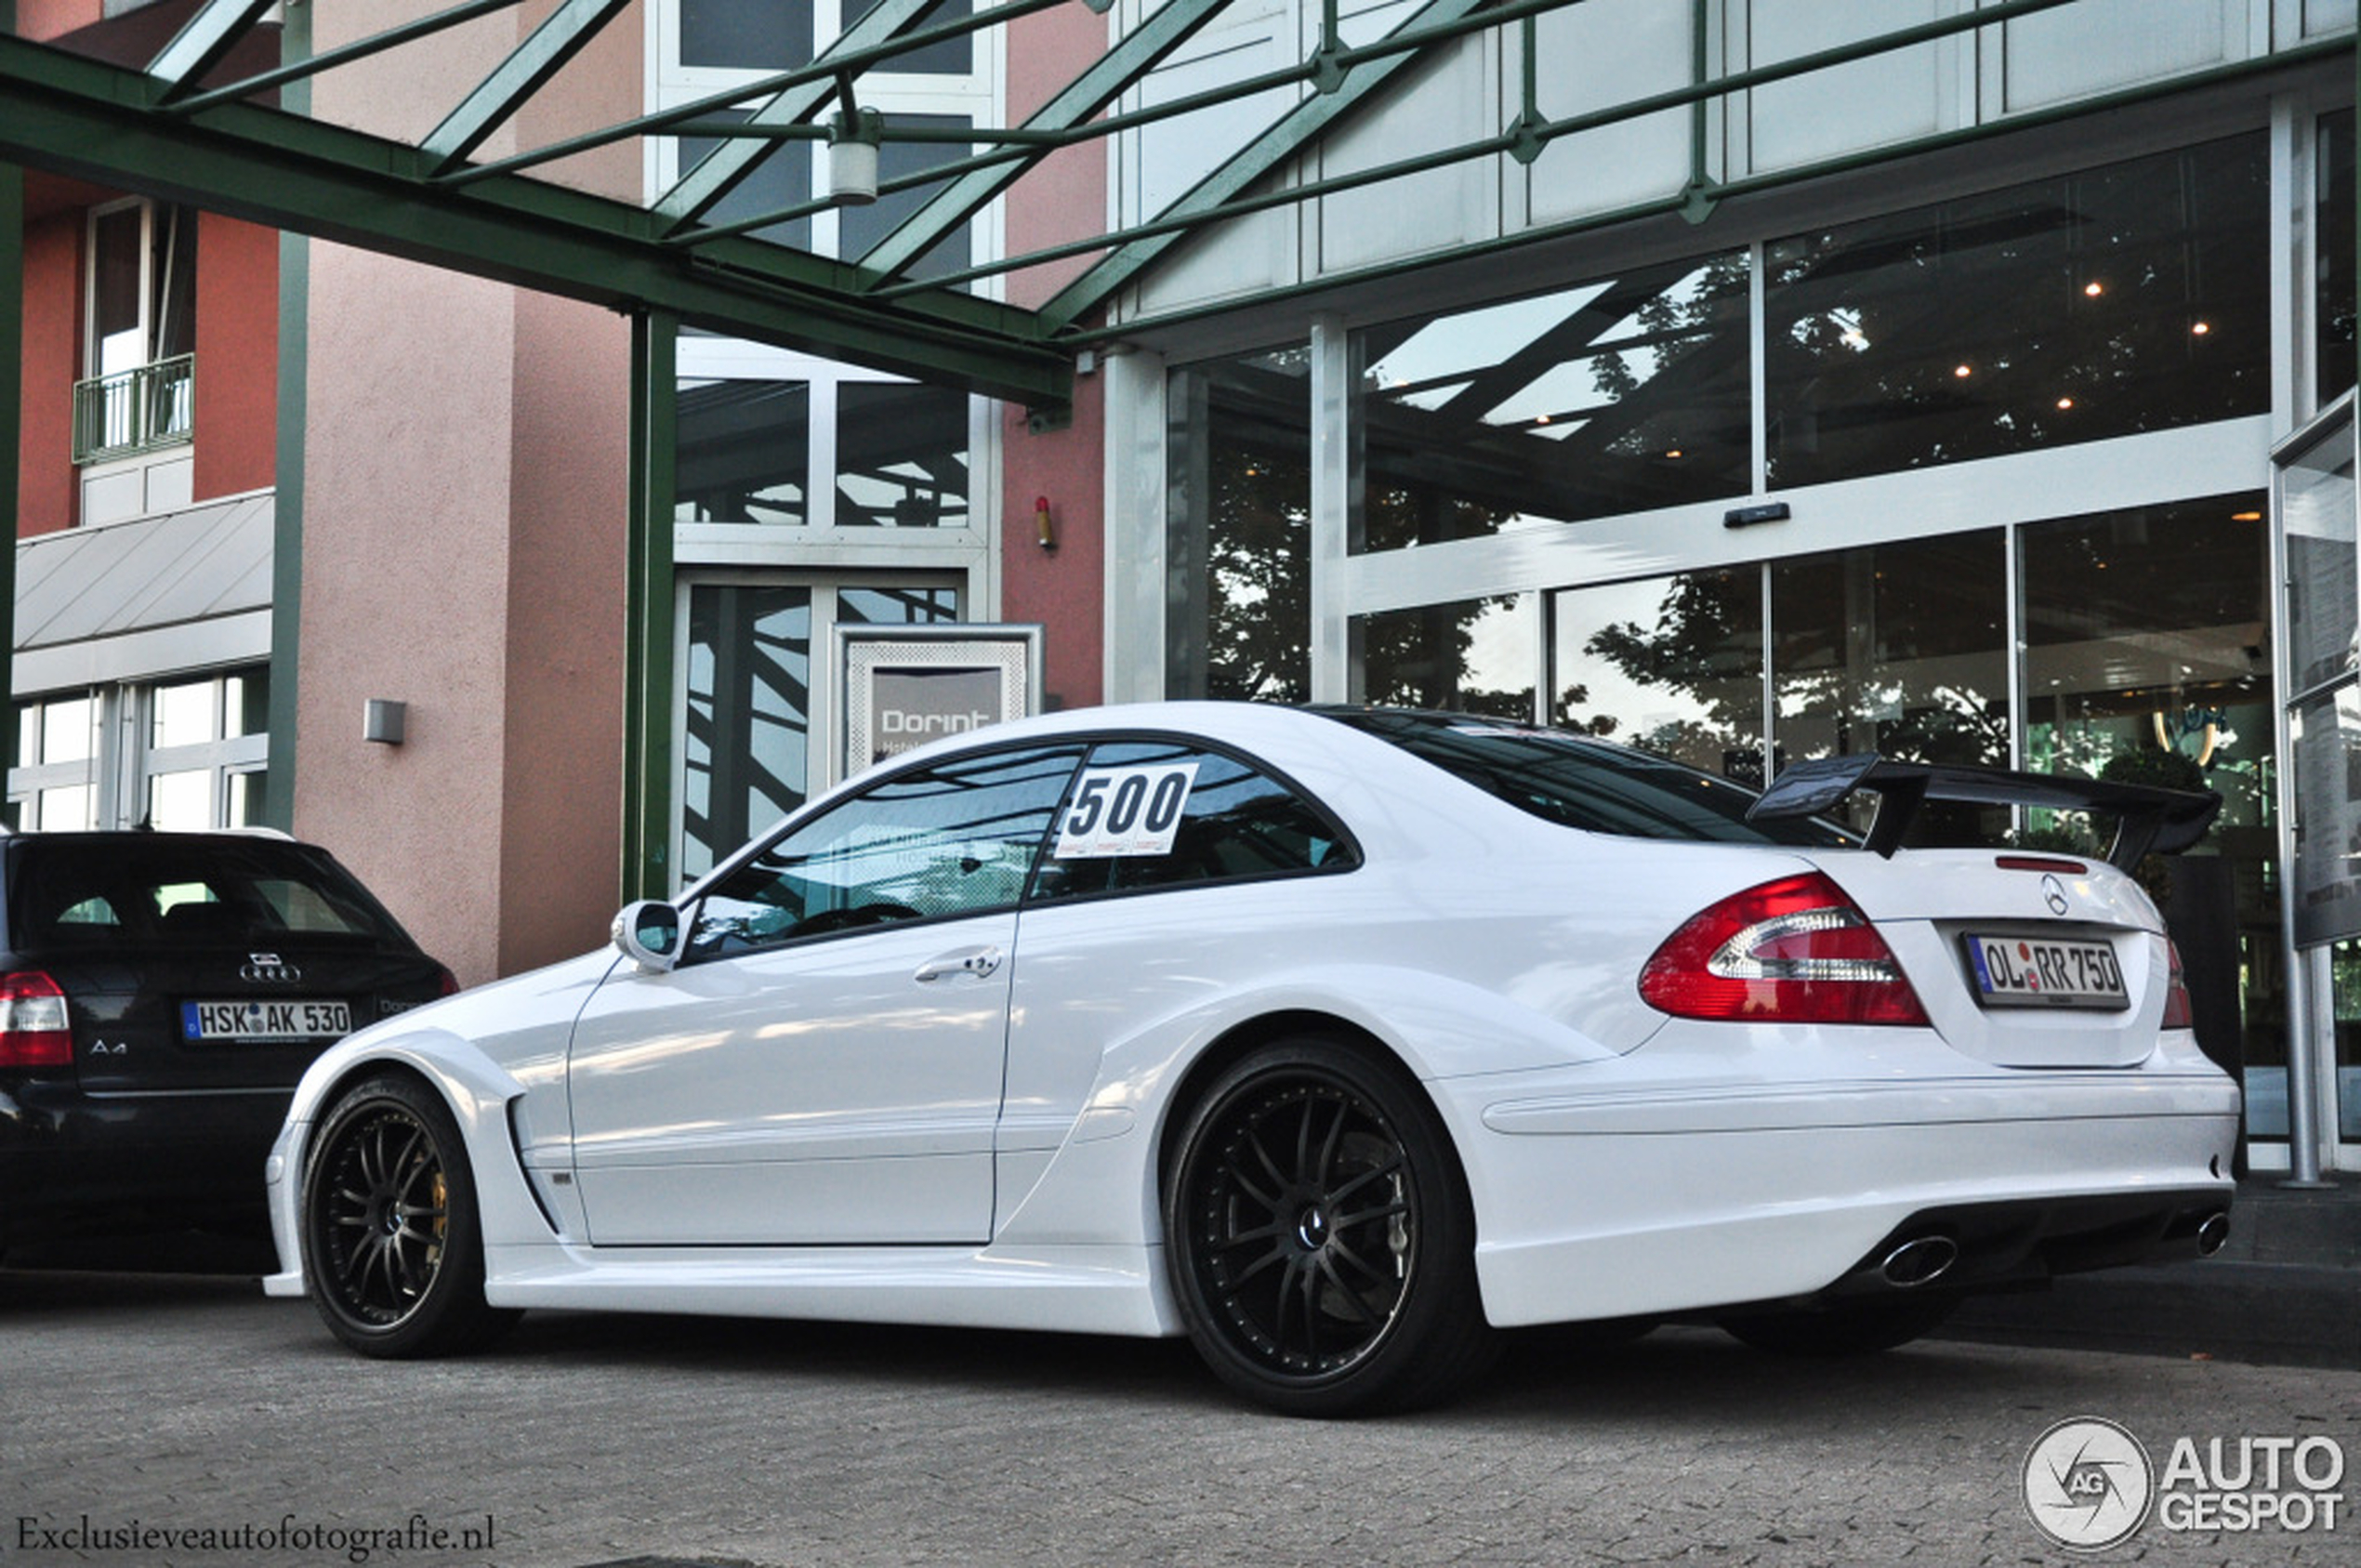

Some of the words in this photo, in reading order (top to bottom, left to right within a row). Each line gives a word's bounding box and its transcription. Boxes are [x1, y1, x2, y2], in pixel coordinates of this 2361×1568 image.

[881, 709, 990, 732] Dorint
[1067, 771, 1187, 837] 500
[1986, 944, 2025, 988] OL
[2033, 946, 2074, 990] RR
[2070, 948, 2119, 992] 750
[199, 1005, 249, 1034] HSK
[267, 1005, 297, 1033] AK
[304, 1005, 350, 1033] 530
